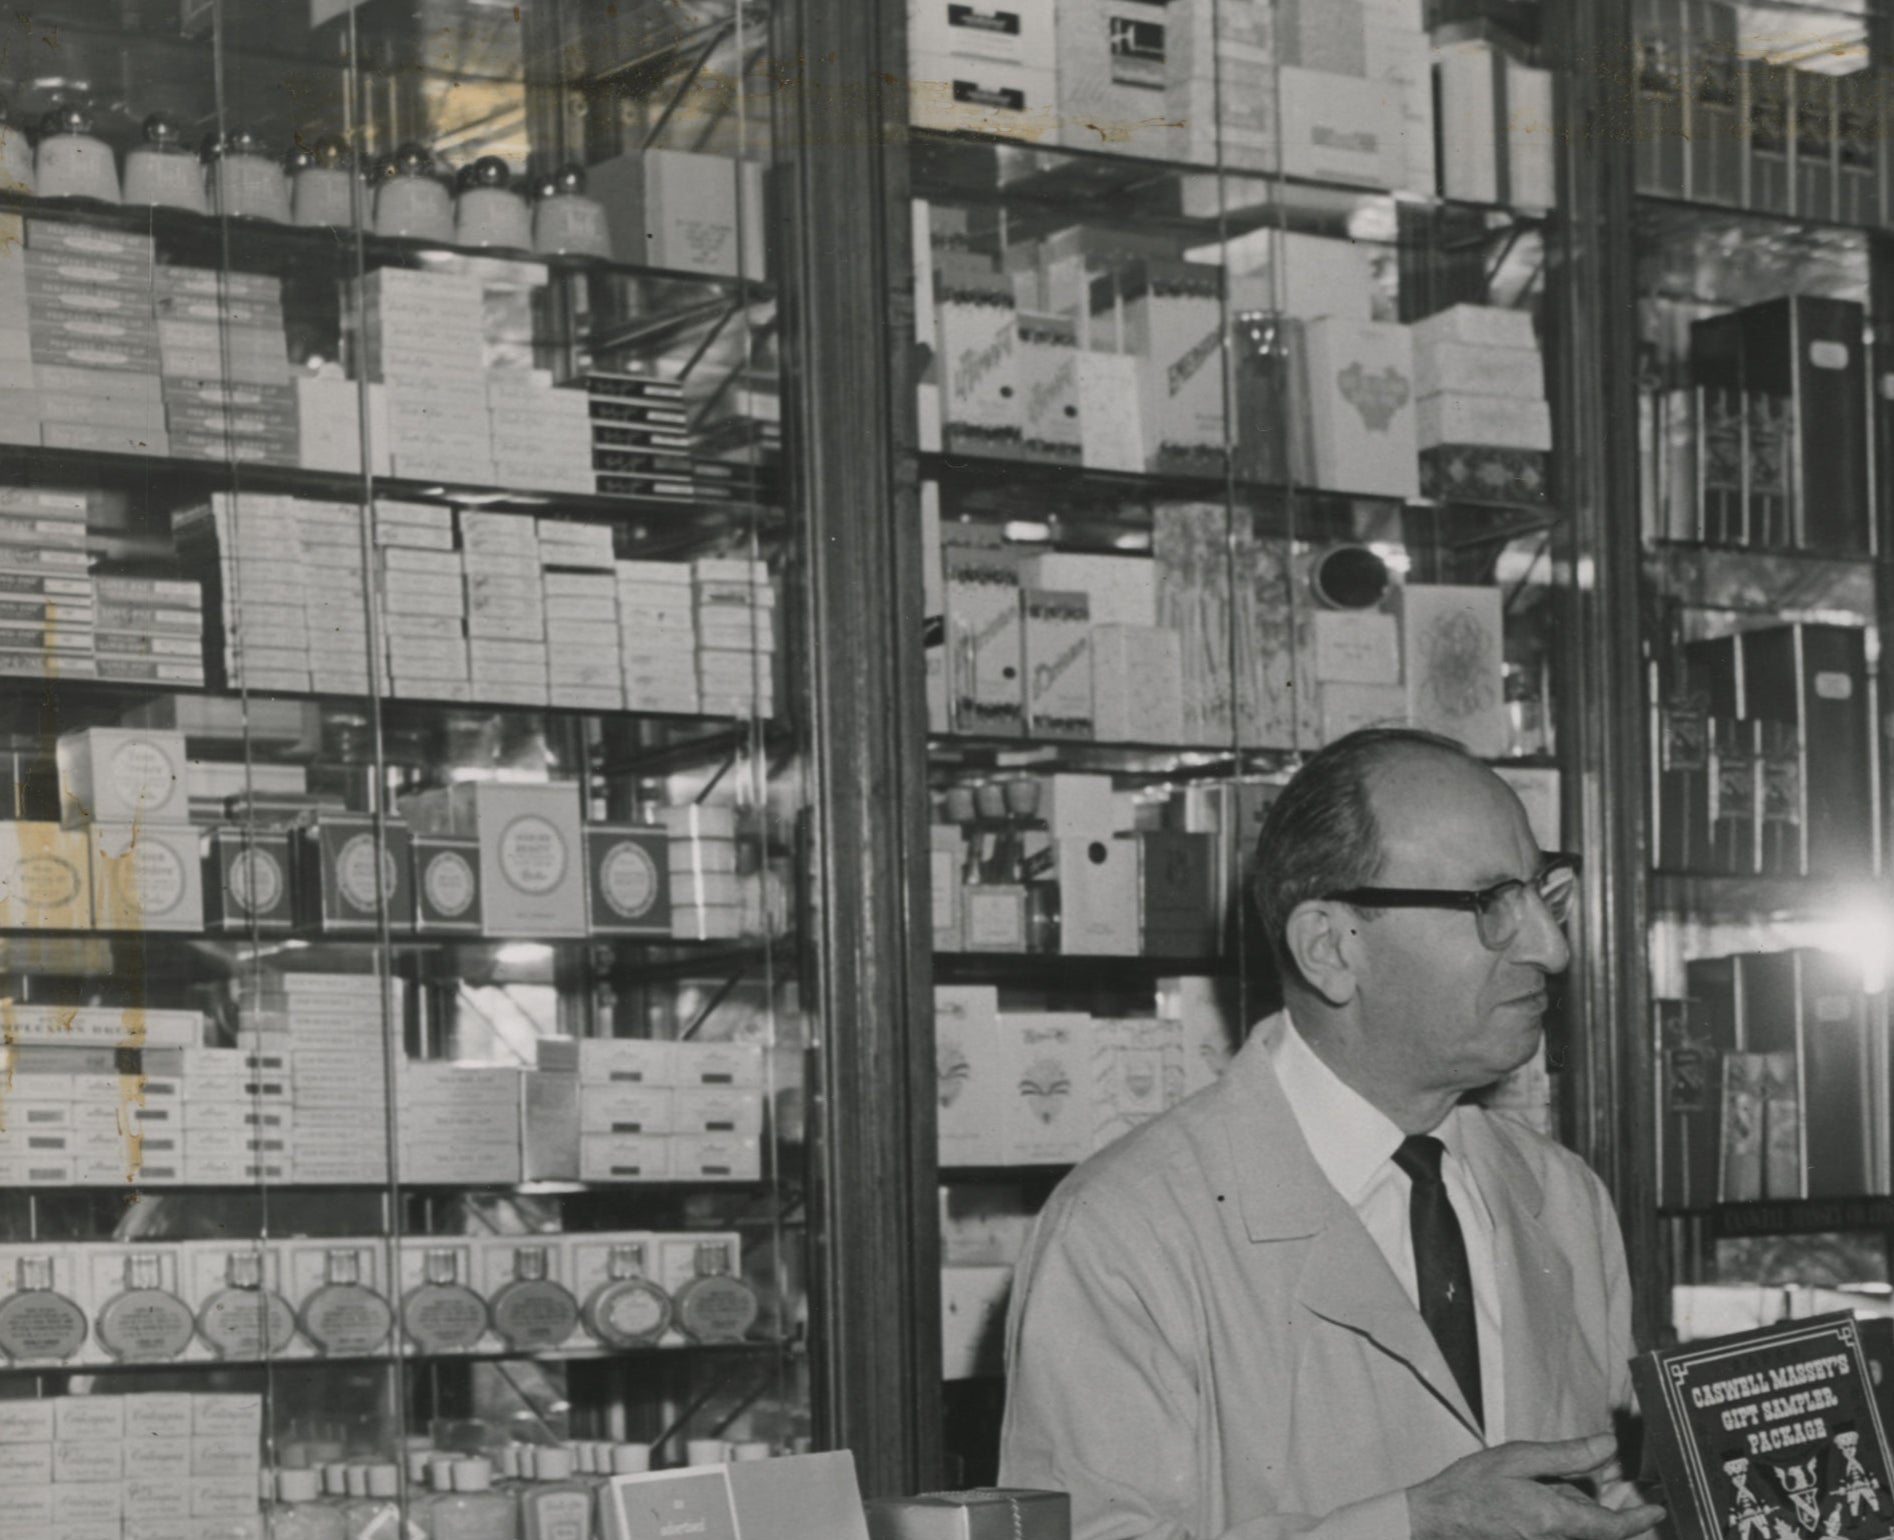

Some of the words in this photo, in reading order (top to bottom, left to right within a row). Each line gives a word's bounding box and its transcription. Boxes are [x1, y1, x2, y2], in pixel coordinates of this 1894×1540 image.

[1691, 1372, 1770, 1409] CASWELL
[1769, 1353, 1850, 1390] MASSEY'S
[1721, 1404, 1759, 1431] GIFT
[1761, 1386, 1839, 1422] SAMPLER
[1747, 1417, 1828, 1455] PACKAGE
